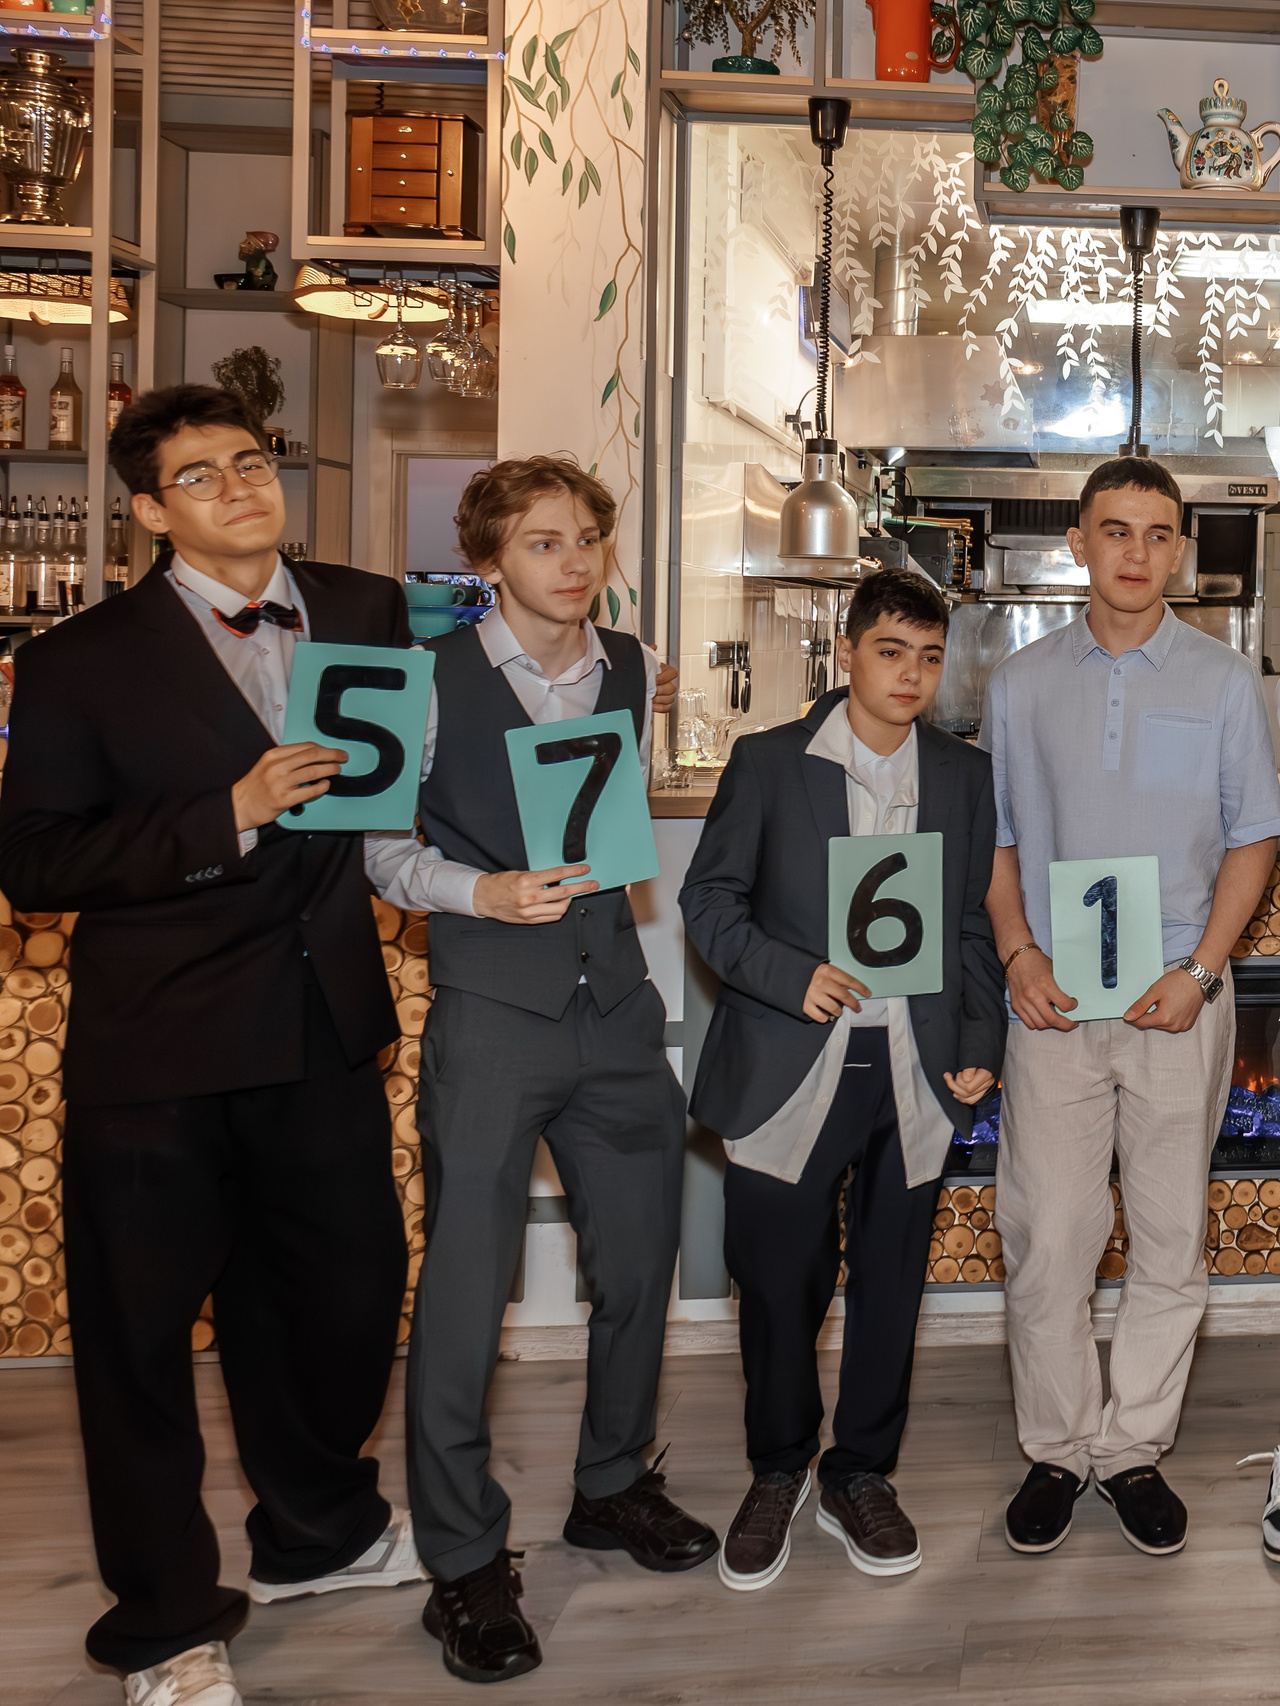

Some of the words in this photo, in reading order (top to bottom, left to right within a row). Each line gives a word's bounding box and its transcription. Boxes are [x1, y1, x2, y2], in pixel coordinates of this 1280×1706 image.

[310, 664, 408, 798] 5
[534, 732, 622, 864] 7
[846, 852, 923, 968] 6
[1083, 875, 1118, 989] 1
